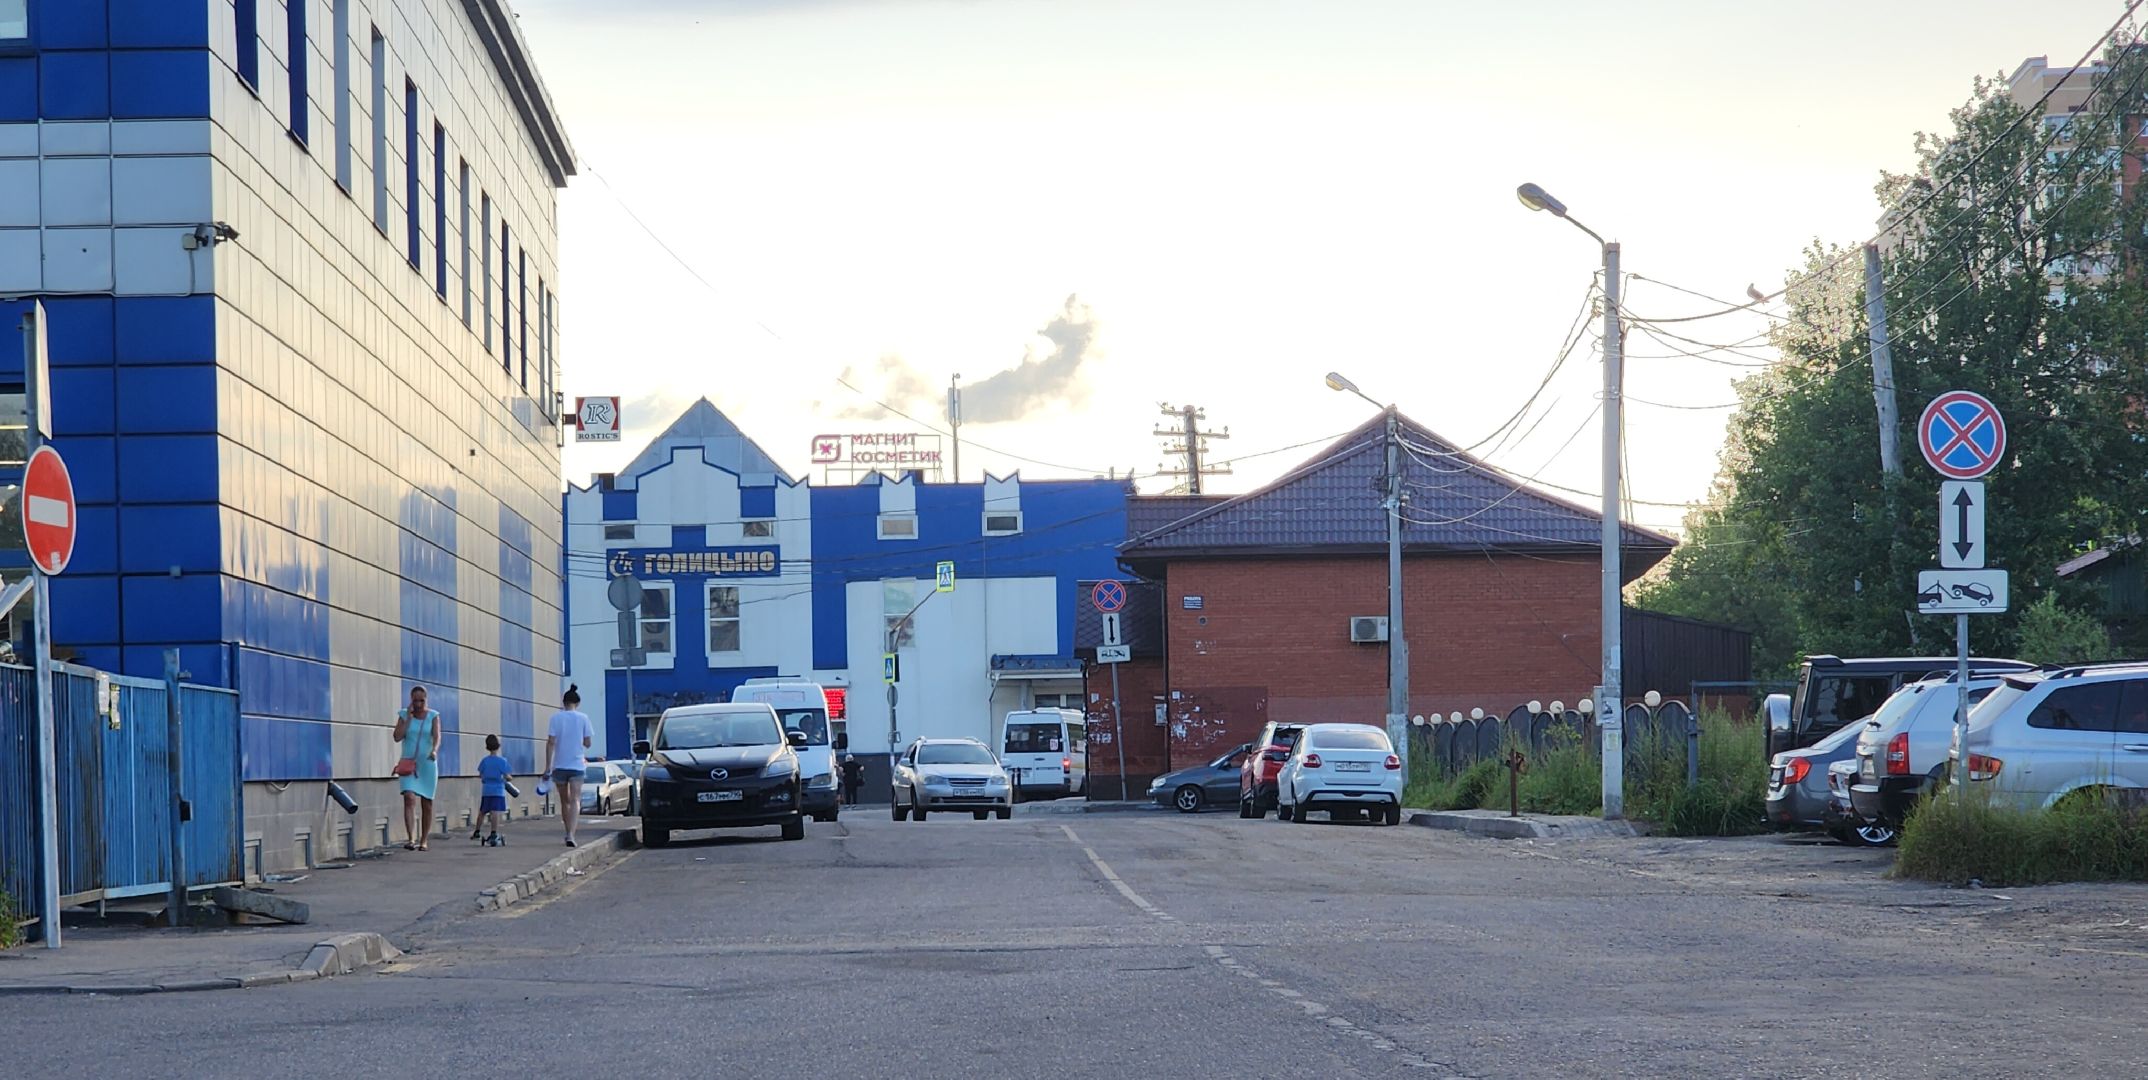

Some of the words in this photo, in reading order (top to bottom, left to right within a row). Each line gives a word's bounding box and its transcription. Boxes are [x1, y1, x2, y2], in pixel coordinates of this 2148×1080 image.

[851, 433, 918, 445] МАГНИТ
[851, 451, 943, 463] КОСМЕТИК
[645, 551, 775, 575] ГОЛИЦЫНО
